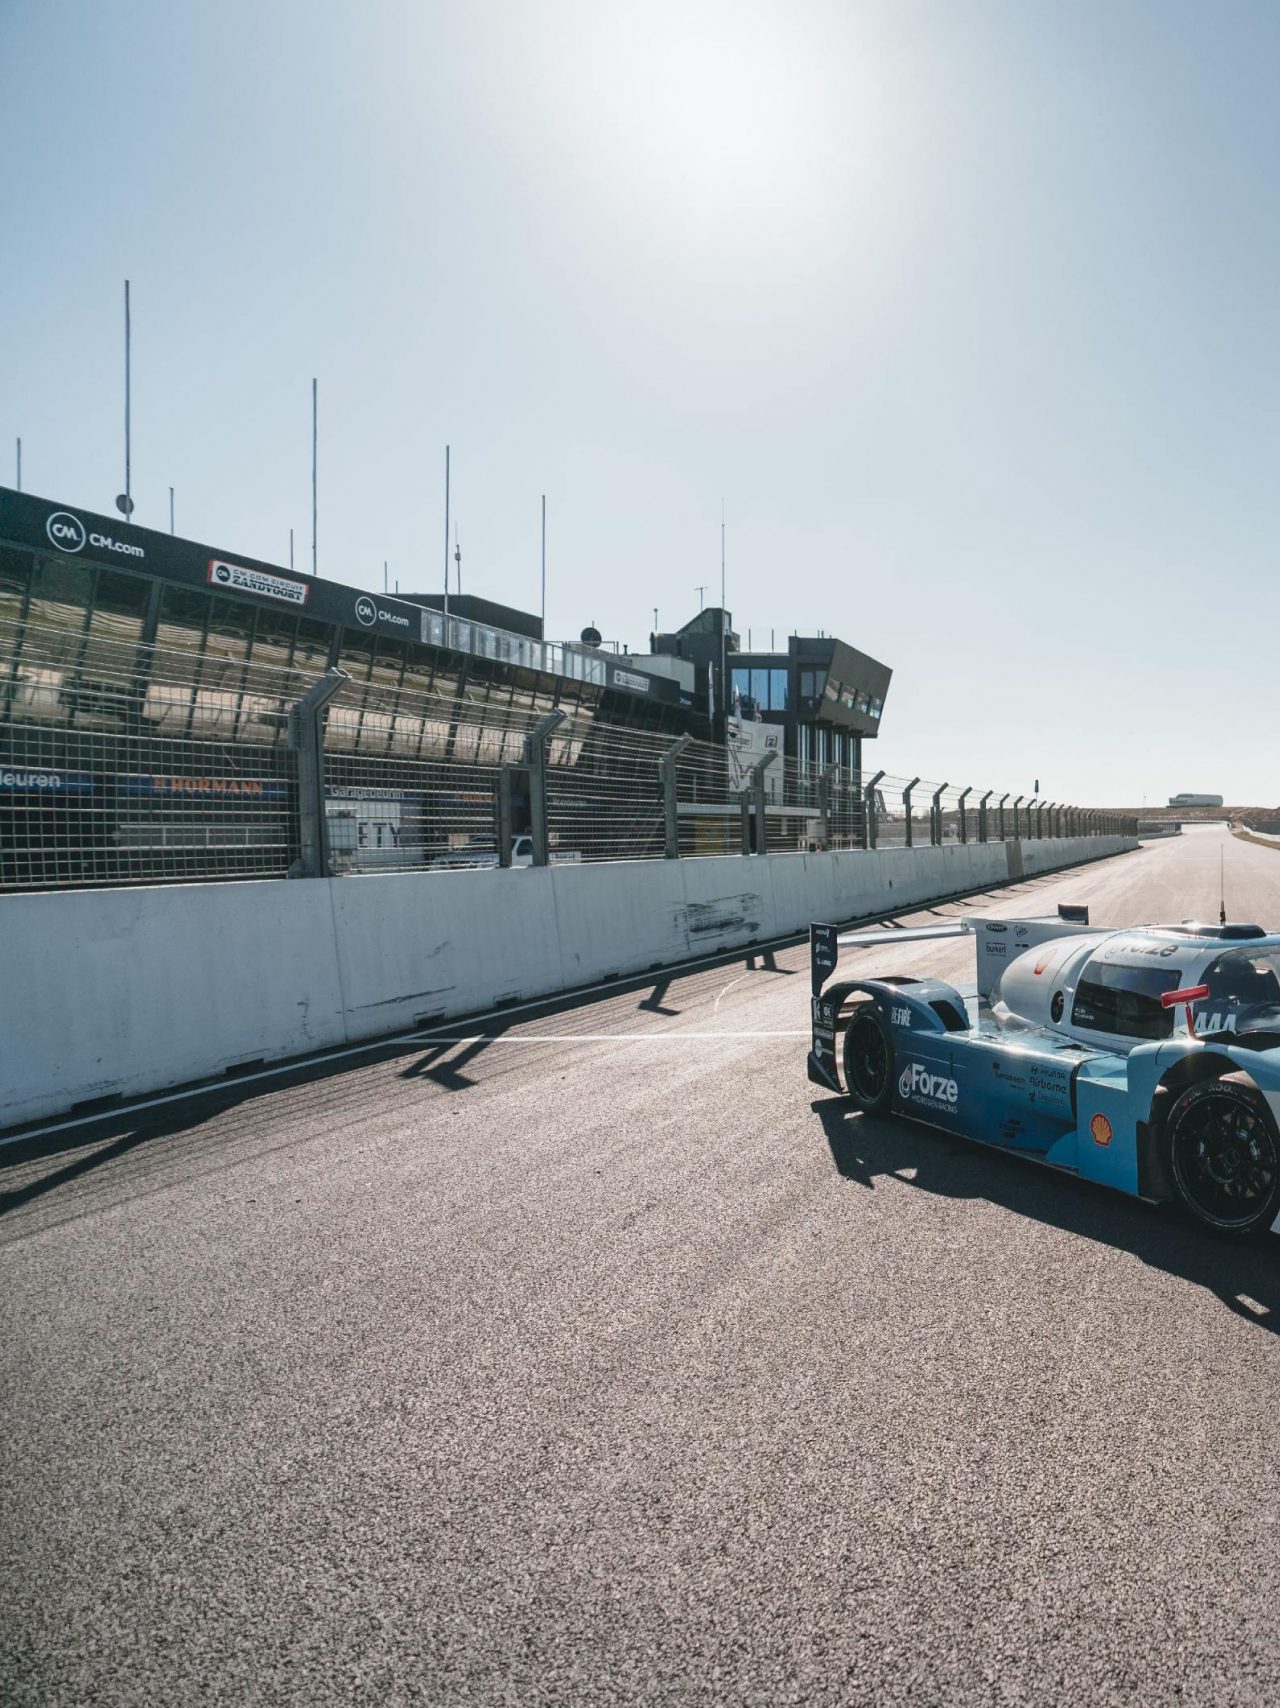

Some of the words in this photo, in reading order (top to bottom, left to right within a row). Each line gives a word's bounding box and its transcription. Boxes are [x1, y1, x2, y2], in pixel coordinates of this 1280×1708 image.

[88, 532, 145, 558] CM.com
[232, 574, 303, 600] ZANDVOORT
[378, 610, 410, 627] CM.com
[911, 1062, 959, 1103] Forze
